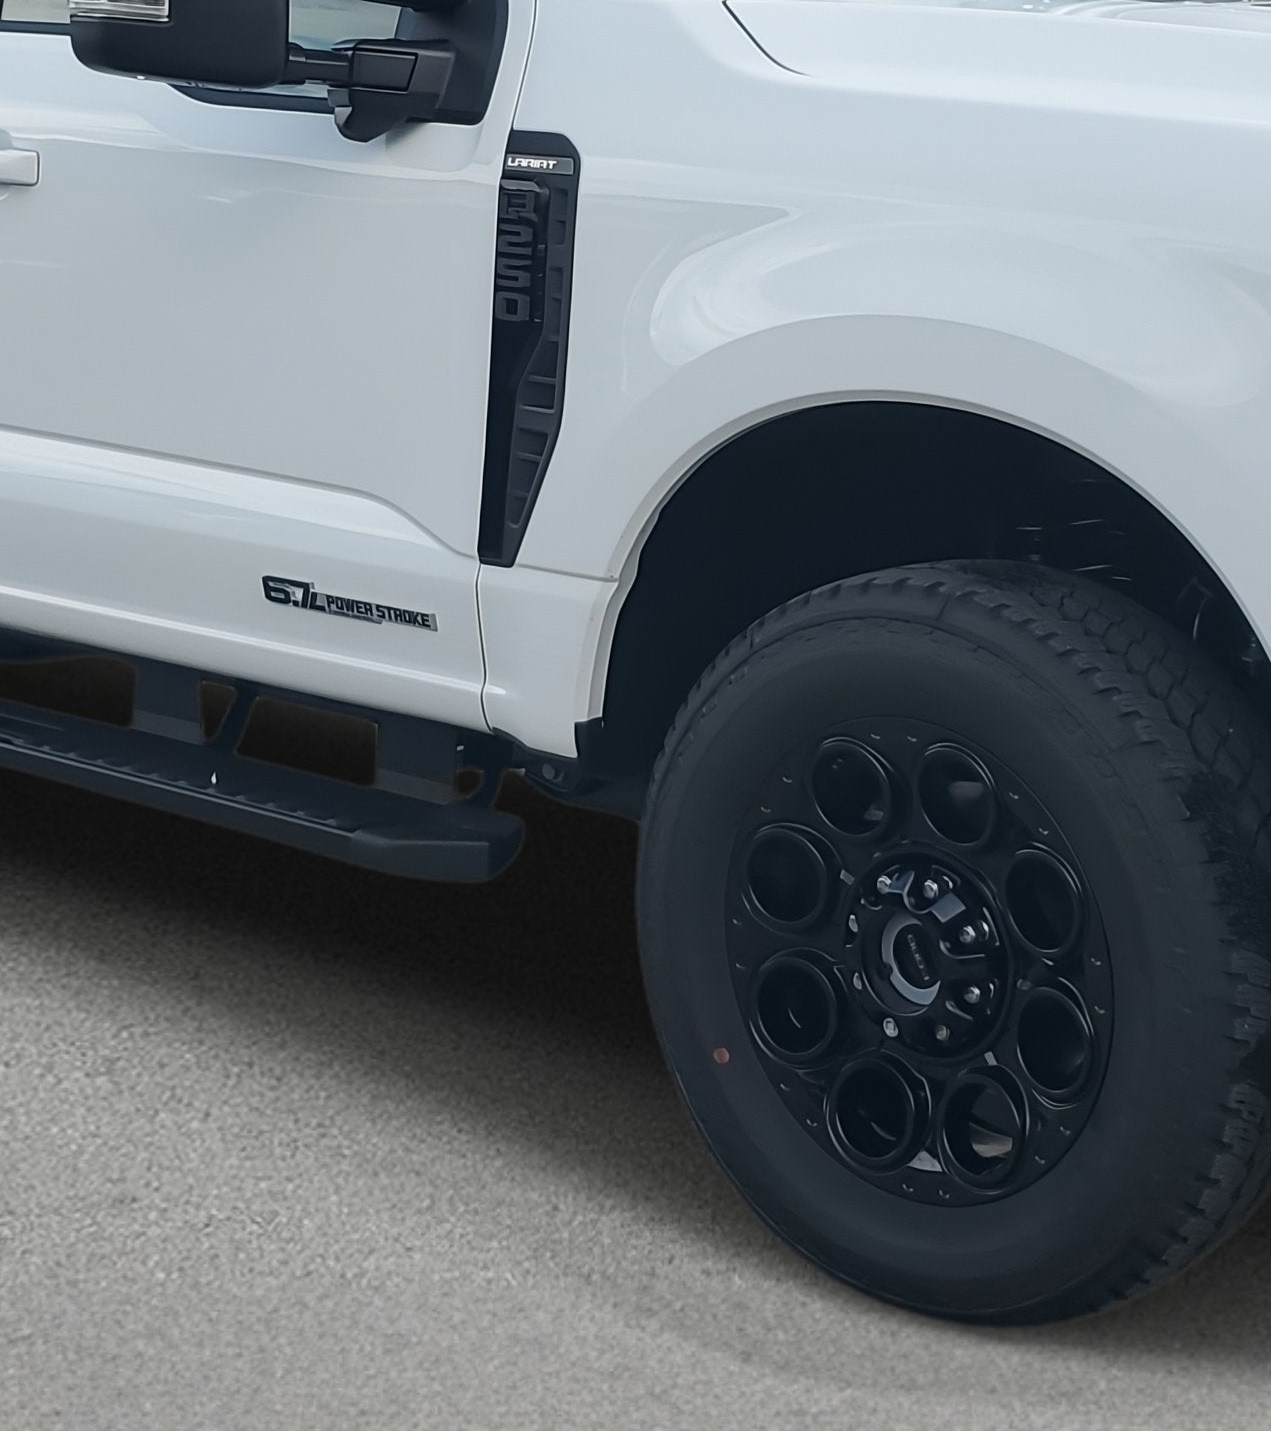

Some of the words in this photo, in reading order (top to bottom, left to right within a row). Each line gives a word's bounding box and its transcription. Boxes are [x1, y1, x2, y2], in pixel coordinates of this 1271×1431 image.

[506, 156, 558, 171] LARIAT
[262, 575, 327, 612] 6.7L
[326, 595, 374, 617] POWER
[375, 604, 432, 628] STROKE
